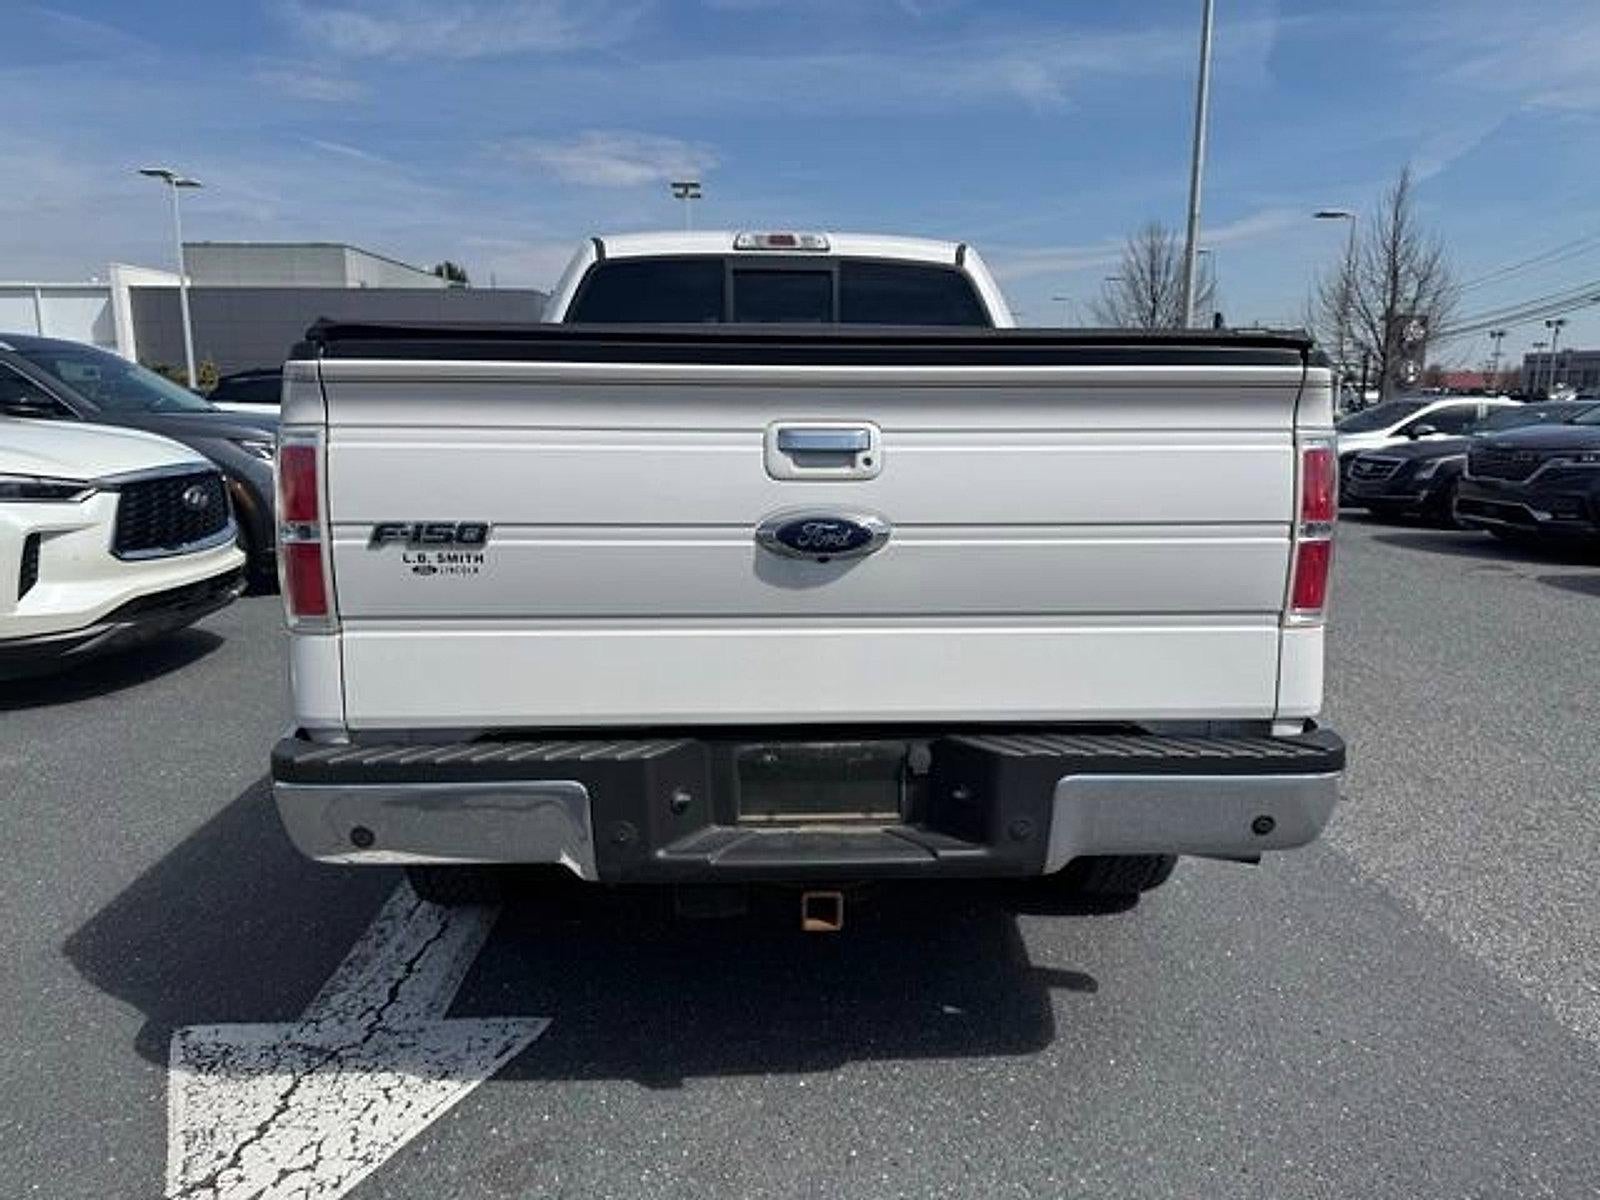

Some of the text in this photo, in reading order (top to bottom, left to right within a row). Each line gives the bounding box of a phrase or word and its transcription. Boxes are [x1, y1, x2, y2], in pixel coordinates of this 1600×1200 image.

[368, 521, 489, 549] F-150
[797, 521, 852, 546] Ford
[437, 553, 484, 564] SMITH
